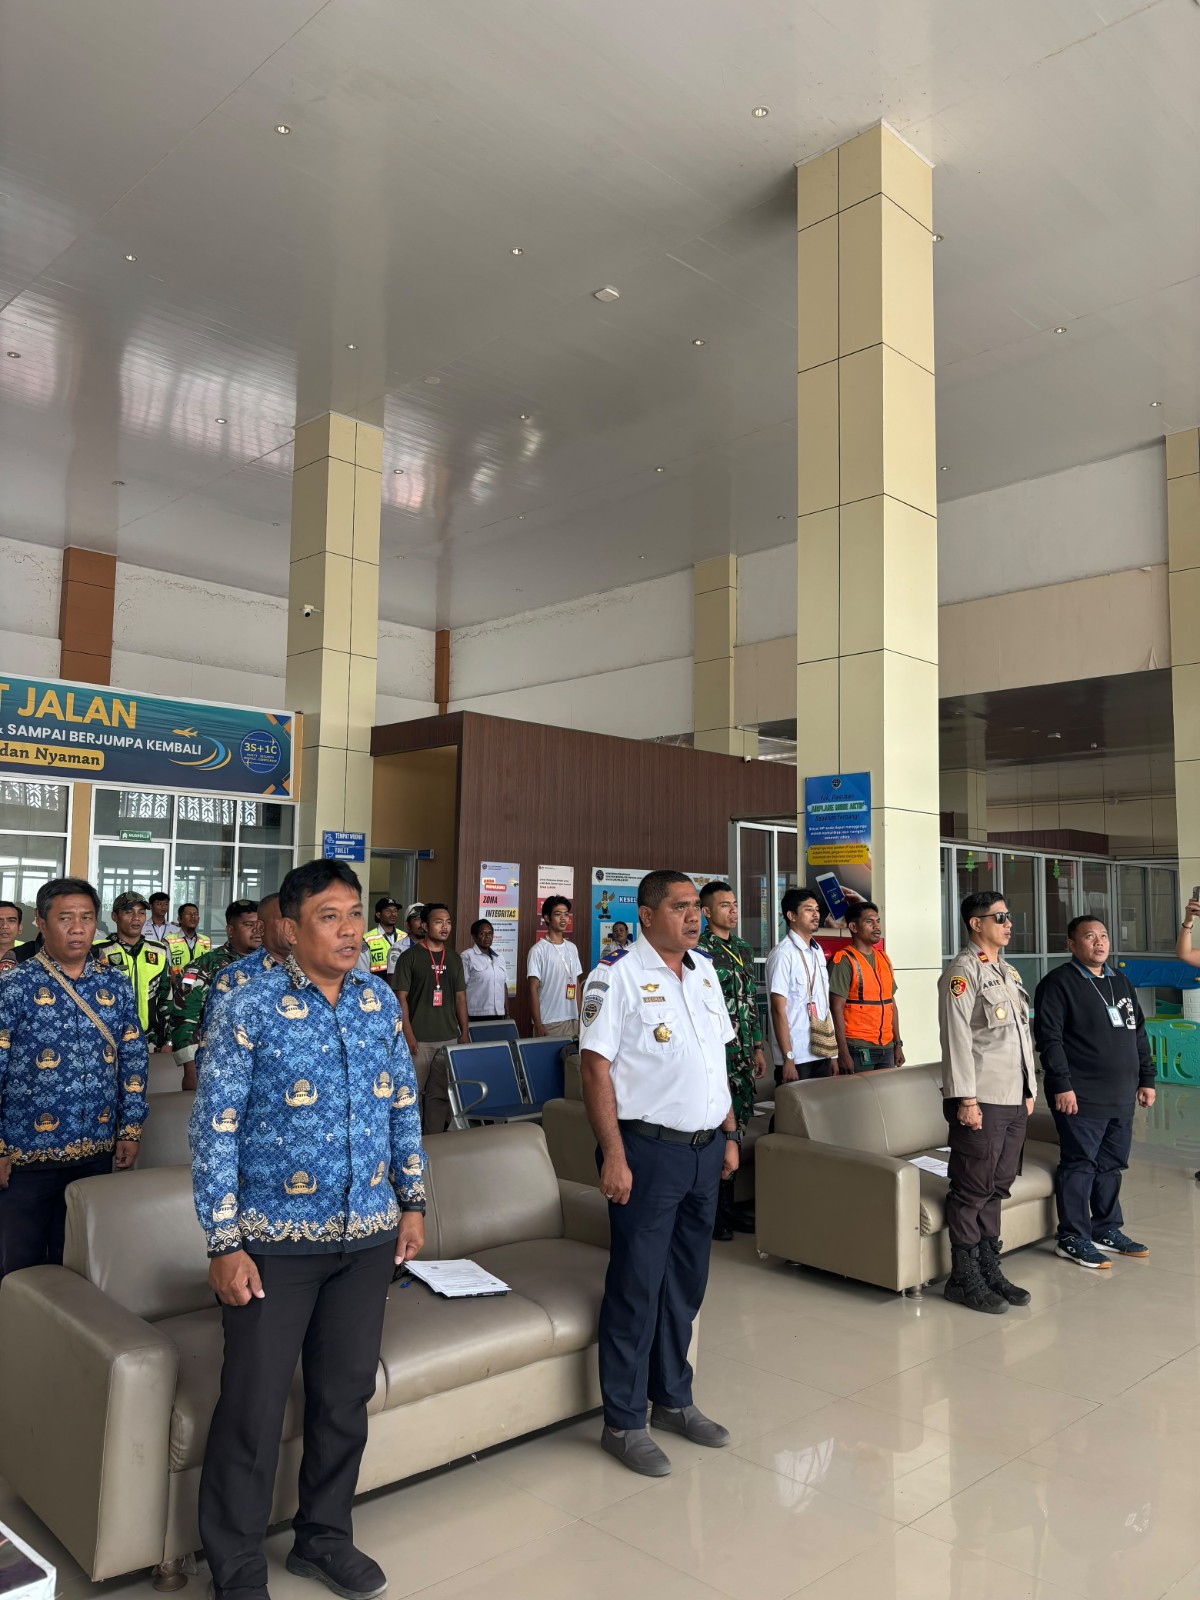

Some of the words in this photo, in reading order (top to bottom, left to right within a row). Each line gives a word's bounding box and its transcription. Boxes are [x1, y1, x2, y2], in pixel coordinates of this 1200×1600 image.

[17, 686, 137, 730] JALAN
[7, 723, 66, 741] SAMPAI
[69, 731, 144, 750] BERJUMPA
[146, 739, 202, 755] KEMBALI
[0, 743, 29, 759] dan
[34, 747, 100, 765] Nyaman
[244, 742, 278, 755] 3S+1C
[482, 895, 498, 904] ZONA
[484, 909, 517, 918] INTEGRITAS
